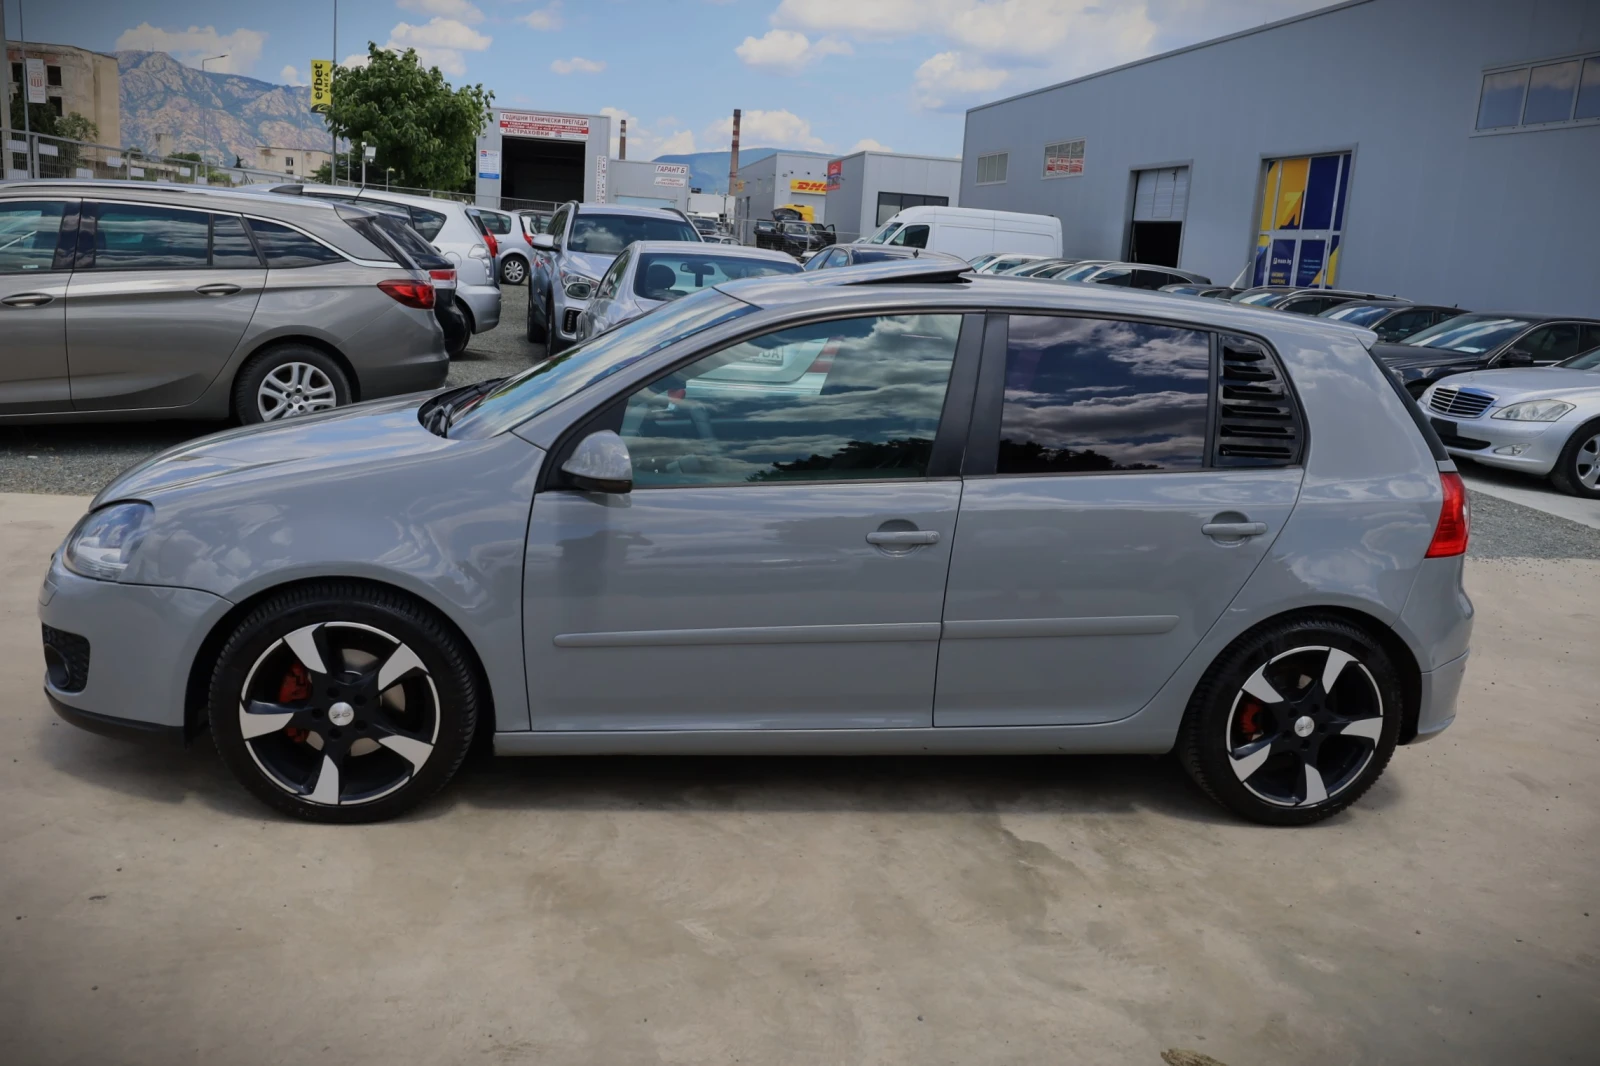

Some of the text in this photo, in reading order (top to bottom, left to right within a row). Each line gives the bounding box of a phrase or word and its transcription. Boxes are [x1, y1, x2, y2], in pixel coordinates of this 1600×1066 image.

[314, 63, 323, 99] efbet
[502, 113, 588, 126] ГОДИШНИ ТЕХНИЧЕСКИ ПРЕГЛЕДИ
[504, 128, 550, 137] ЗАСТРАХОВКИ
[656, 165, 680, 173] ГАРАНТ
